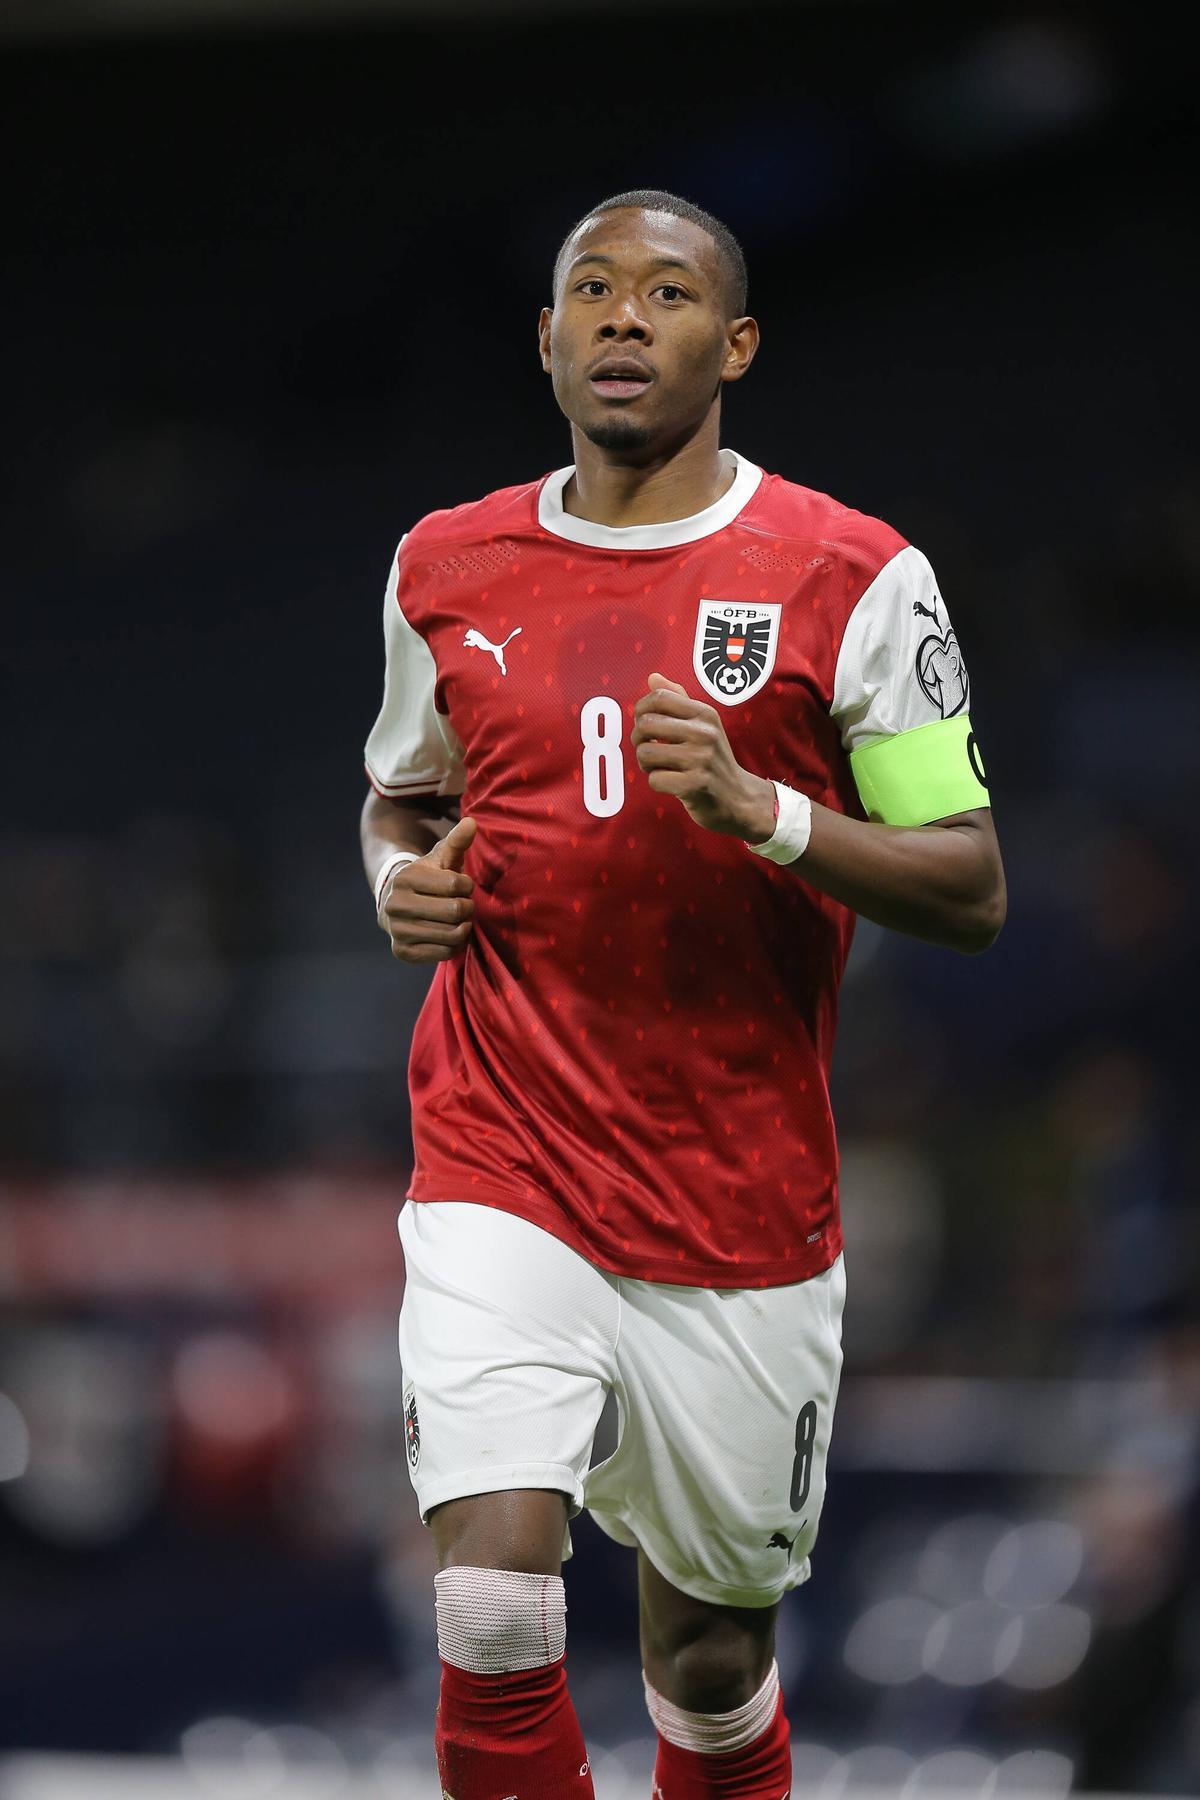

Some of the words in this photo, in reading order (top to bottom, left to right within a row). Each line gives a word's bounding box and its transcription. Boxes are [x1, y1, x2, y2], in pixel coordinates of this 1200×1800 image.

[723, 607, 757, 618] ÖFB
[580, 696, 625, 818] 8
[790, 1400, 817, 1512] 8
